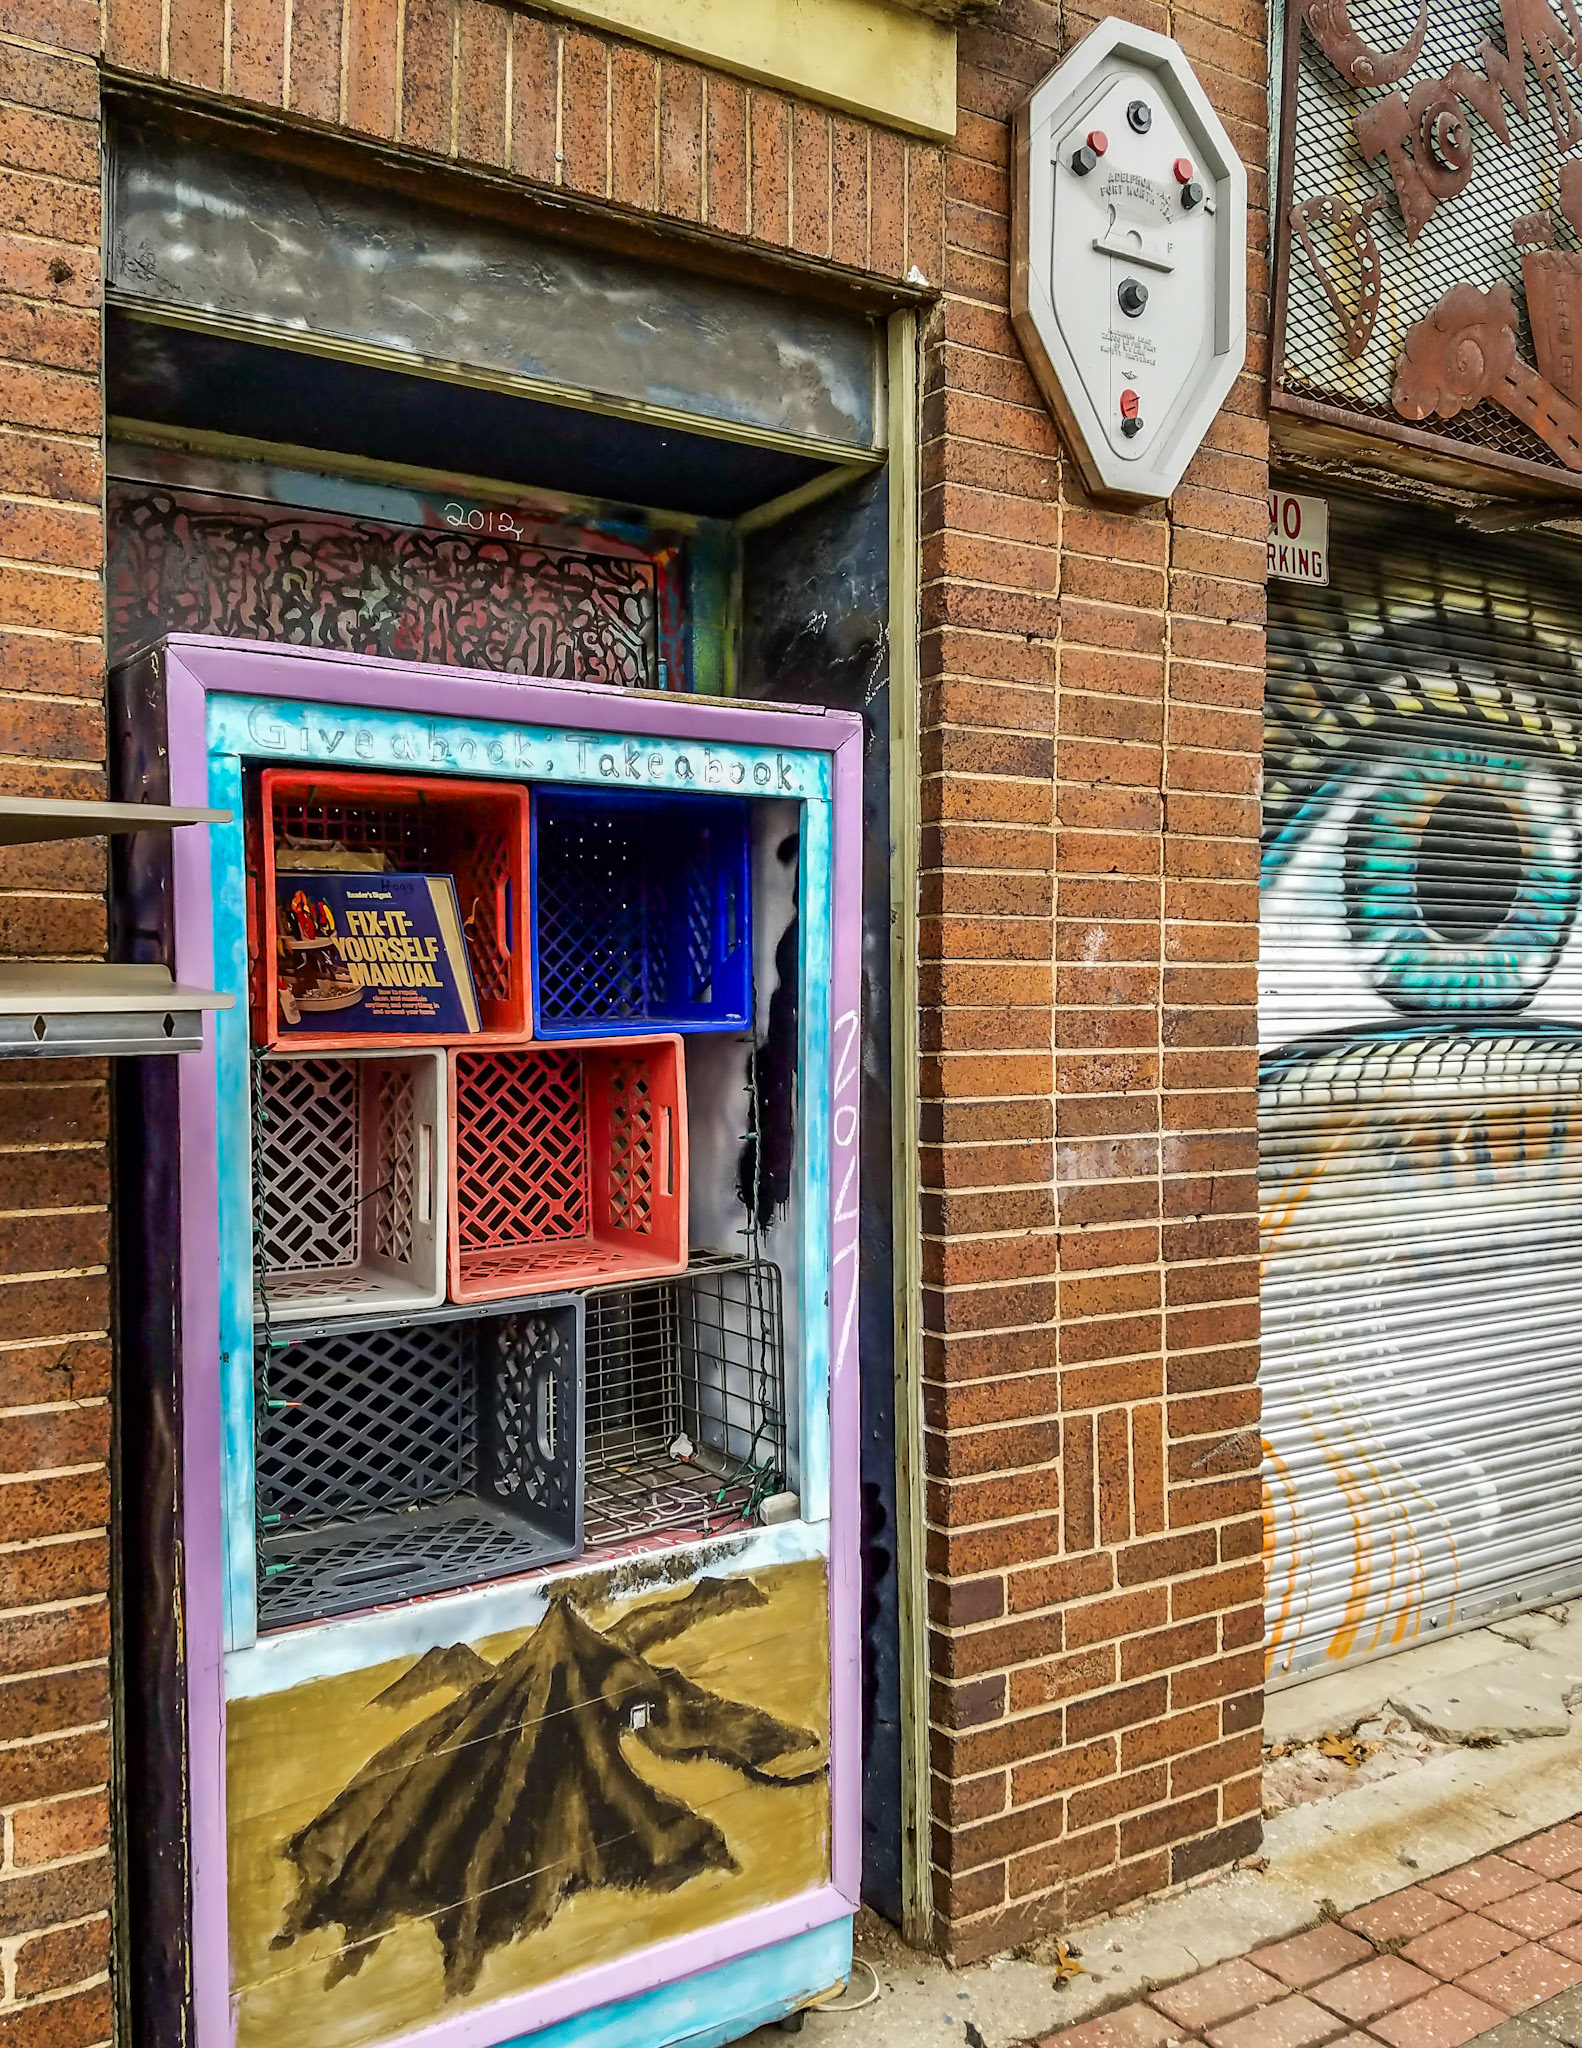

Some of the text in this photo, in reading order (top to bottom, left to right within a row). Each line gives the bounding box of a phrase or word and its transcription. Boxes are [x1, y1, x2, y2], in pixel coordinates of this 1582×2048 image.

[1100, 184, 1123, 197] FORT
[444, 503, 523, 541] 2012
[1268, 495, 1301, 540] NO
[1266, 542, 1322, 578] RKING
[248, 701, 374, 759] Give
[565, 734, 665, 780] Take
[345, 910, 413, 936] FIX-IT-
[330, 936, 439, 962] YOURSELF
[346, 962, 444, 987] MANUAL
